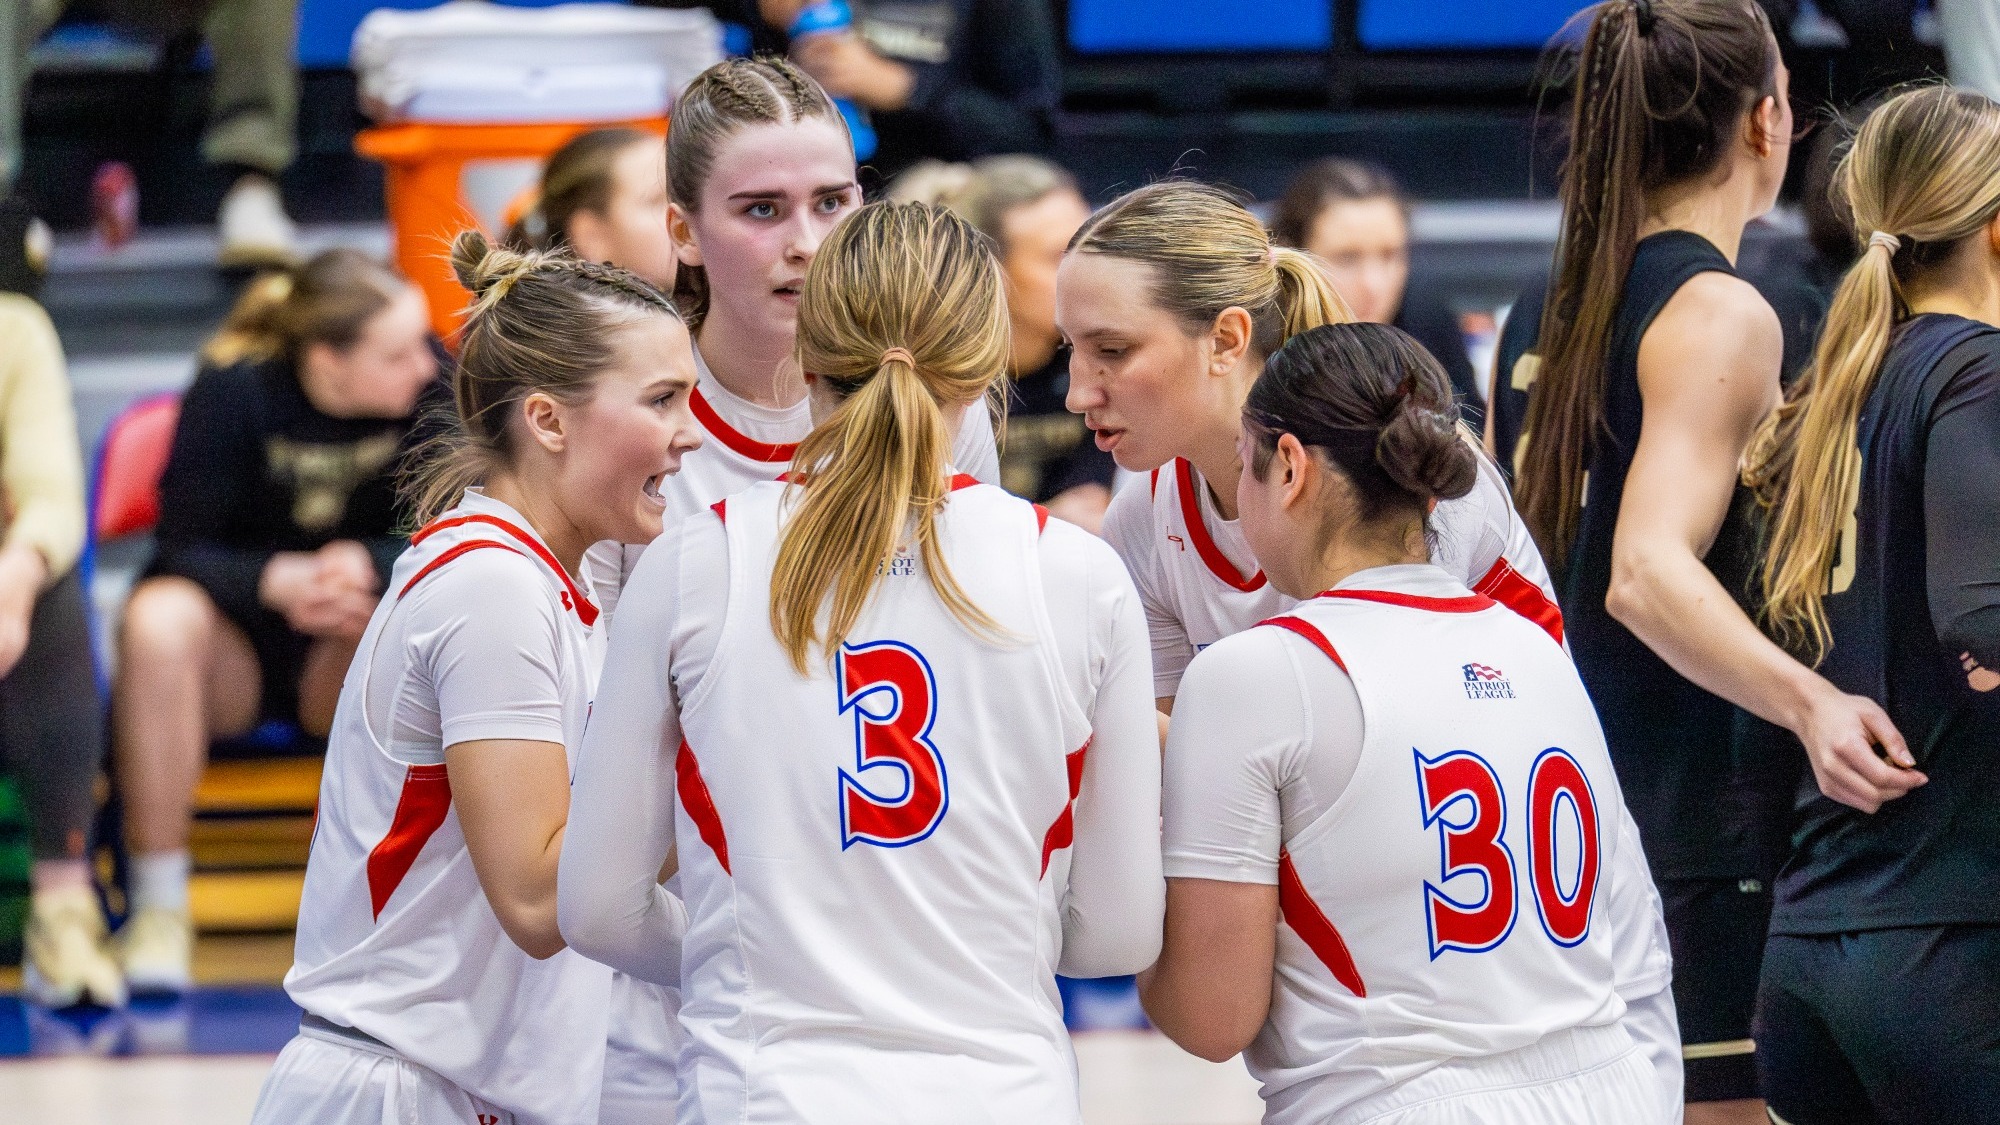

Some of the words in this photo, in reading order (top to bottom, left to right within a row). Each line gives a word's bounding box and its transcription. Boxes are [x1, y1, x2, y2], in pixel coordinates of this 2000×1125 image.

[1463, 681, 1511, 691] PATRIOT
[1466, 690, 1517, 699] LEAGUE
[835, 639, 950, 852] 3
[1412, 746, 1601, 963] 30
